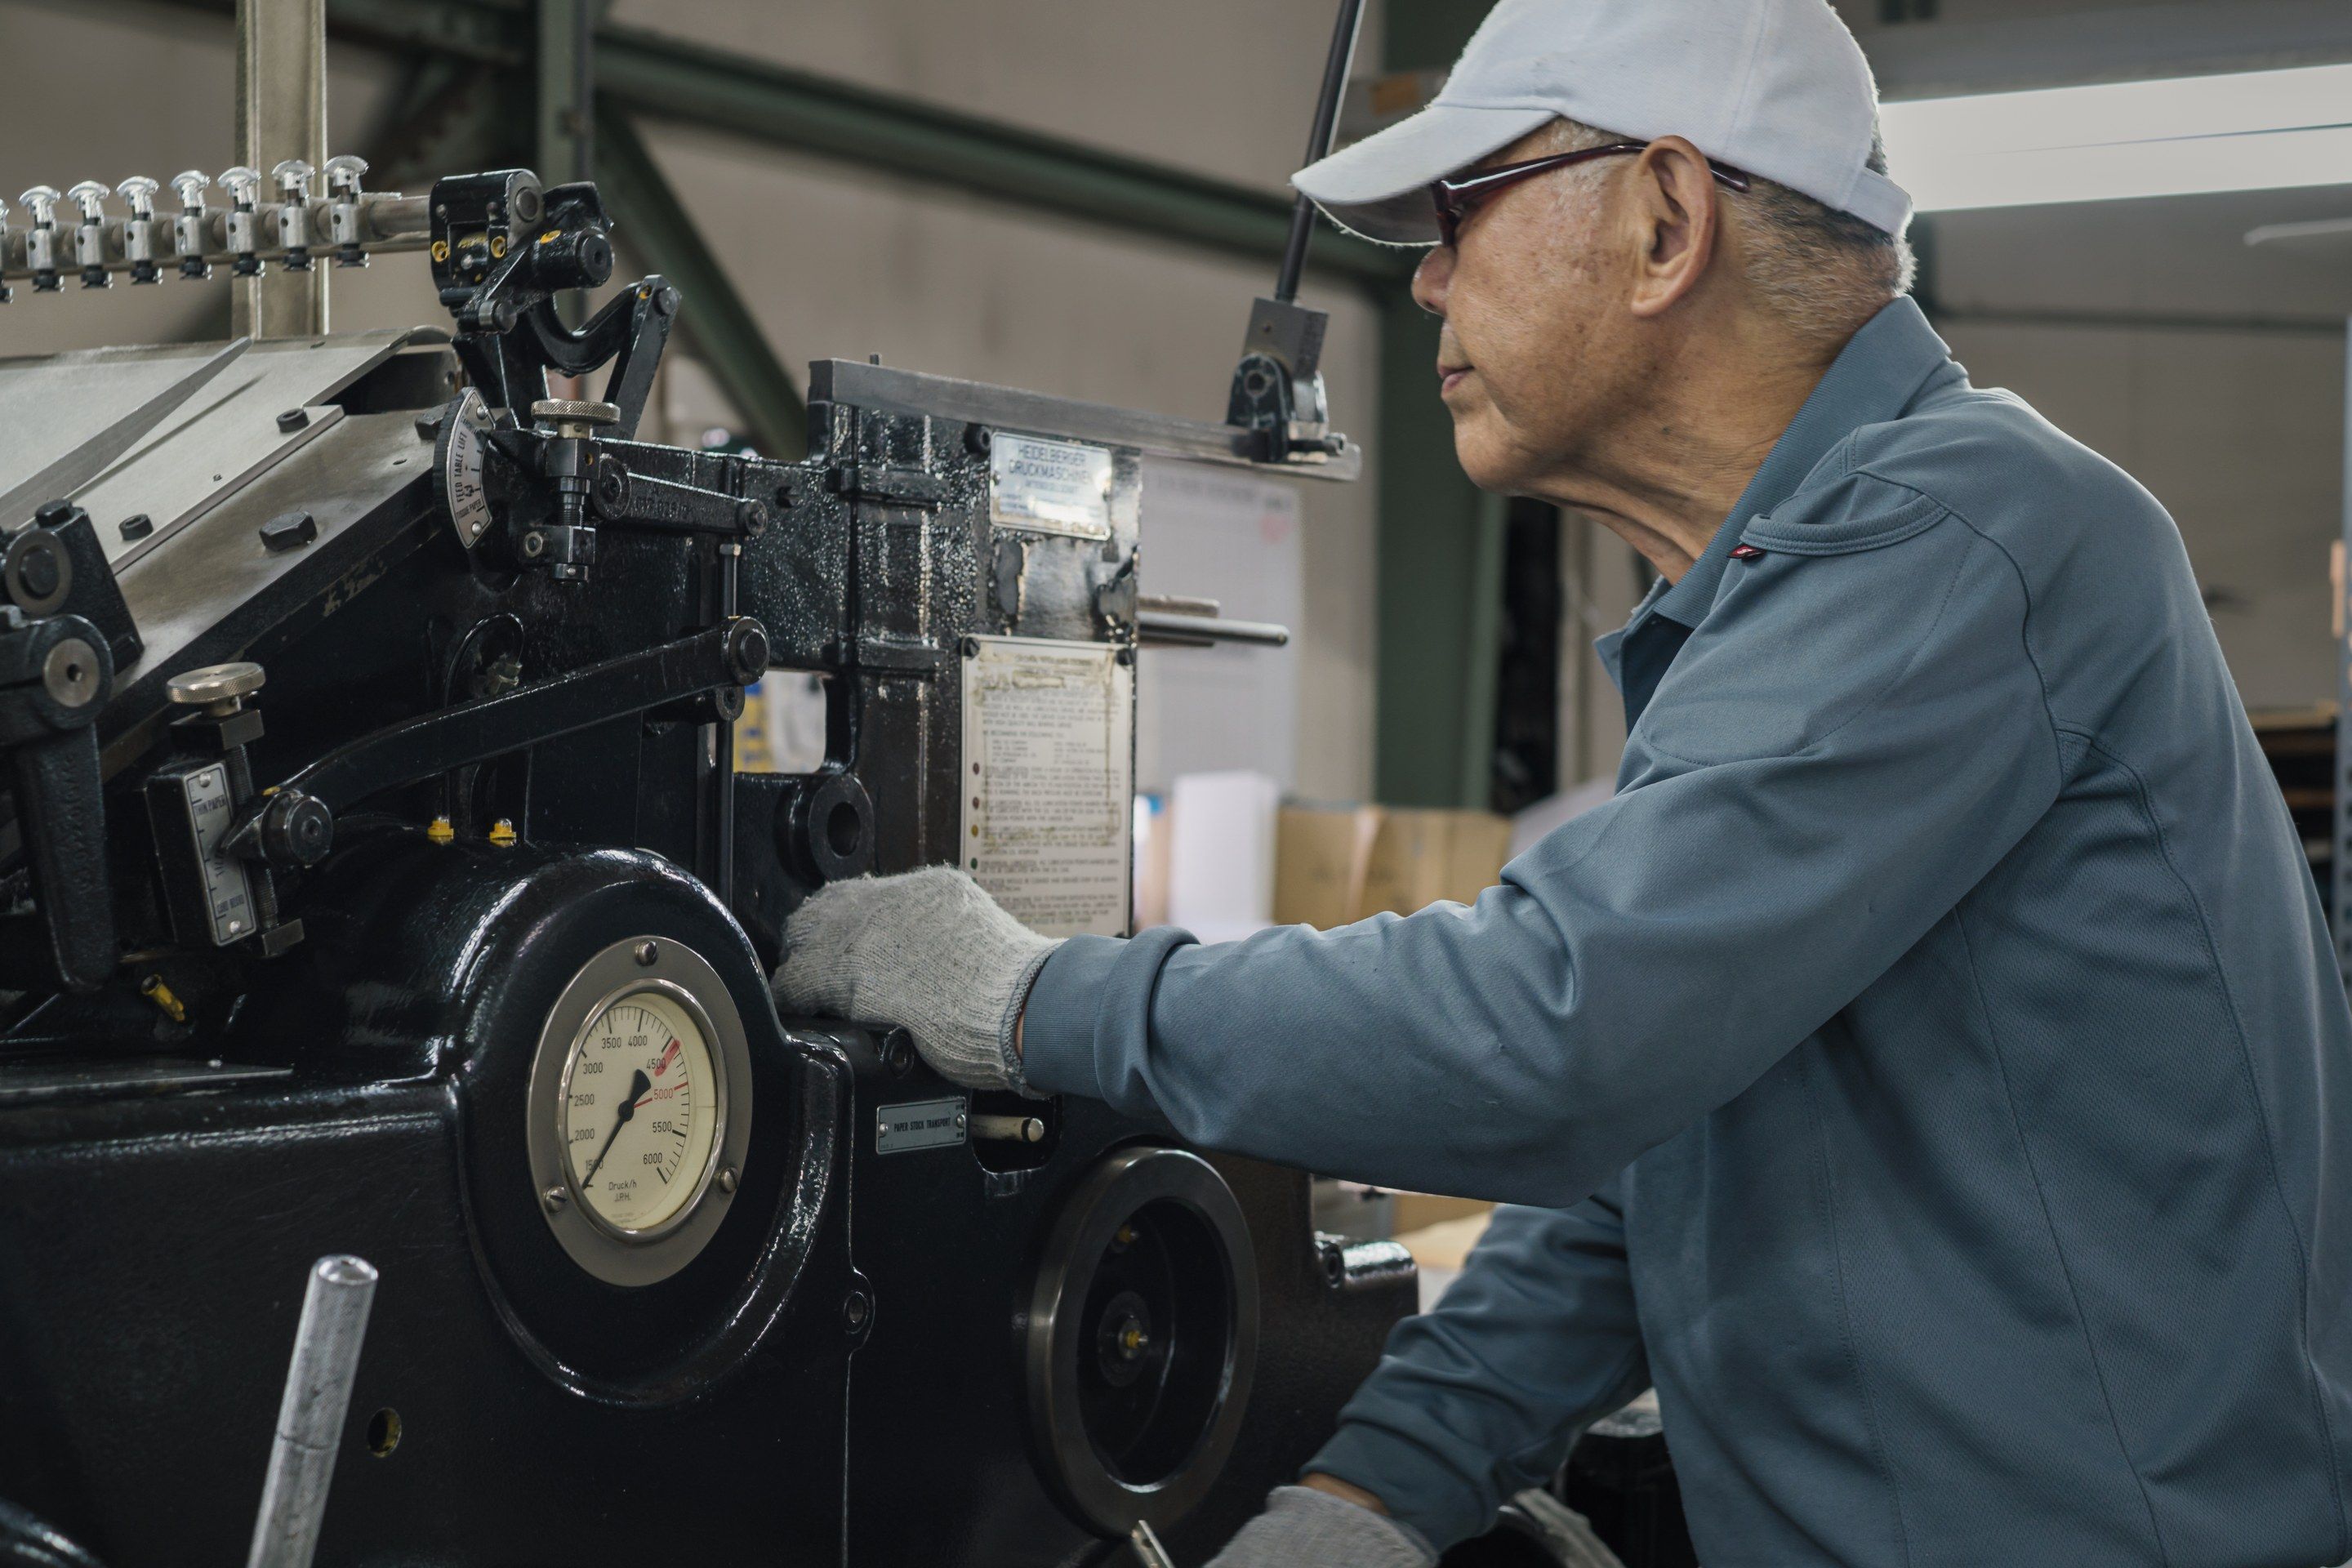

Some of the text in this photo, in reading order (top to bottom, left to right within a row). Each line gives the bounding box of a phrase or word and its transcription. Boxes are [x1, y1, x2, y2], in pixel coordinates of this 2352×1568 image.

[1018, 443, 1086, 467] HEIDELBERGER
[454, 432, 467, 502] FEED TABLE LIFT
[601, 1037, 622, 1049] 3500
[627, 1035, 648, 1047] 4000
[582, 1062, 604, 1075] 3000
[646, 1058, 666, 1071] 4500
[574, 1094, 595, 1107] 2500
[653, 1088, 674, 1100] 5000
[652, 1120, 672, 1134] 5500
[893, 1116, 951, 1133] PAPER STOCK TRANSPORT
[574, 1128, 595, 1141] 2000
[643, 1152, 663, 1165] 6000
[608, 1178, 637, 1191] Druck/h
